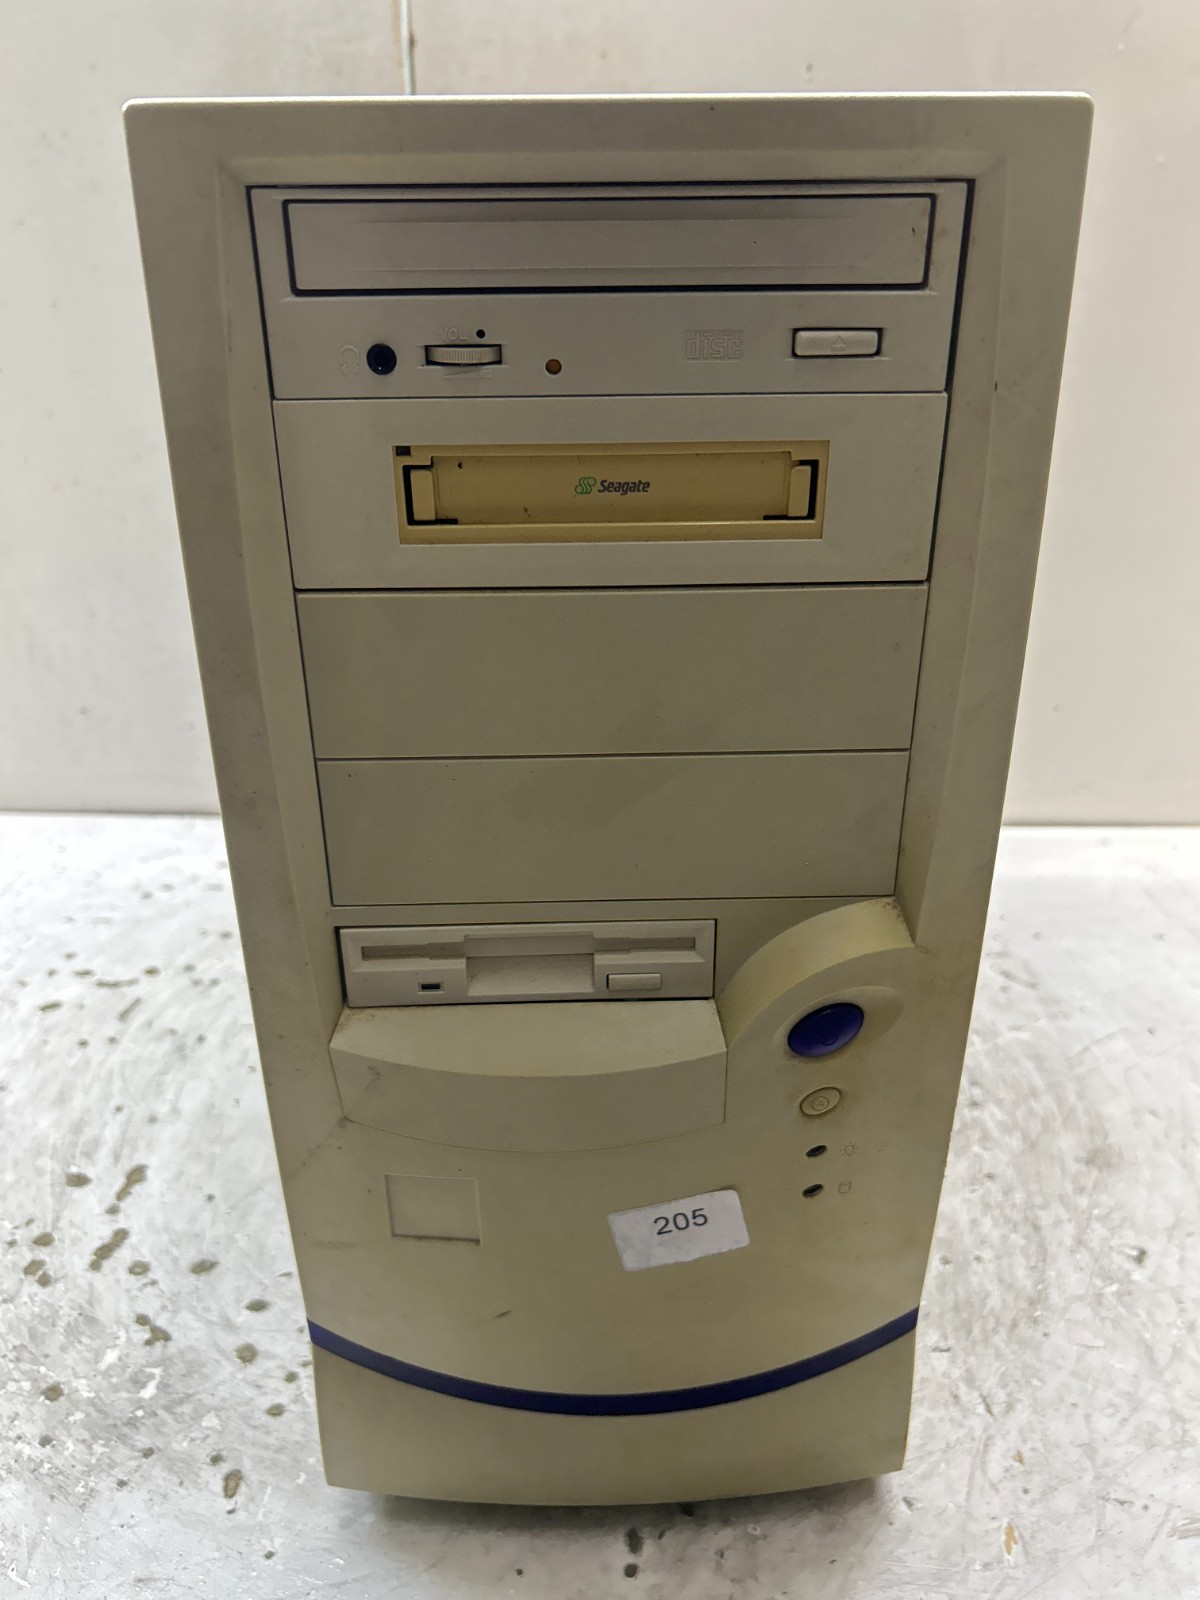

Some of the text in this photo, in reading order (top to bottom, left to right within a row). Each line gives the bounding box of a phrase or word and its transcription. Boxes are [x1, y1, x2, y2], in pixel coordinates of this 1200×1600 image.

[439, 327, 468, 341] VOL
[685, 330, 743, 361] disc
[597, 479, 651, 496] Seagate
[653, 1207, 708, 1236] 205
